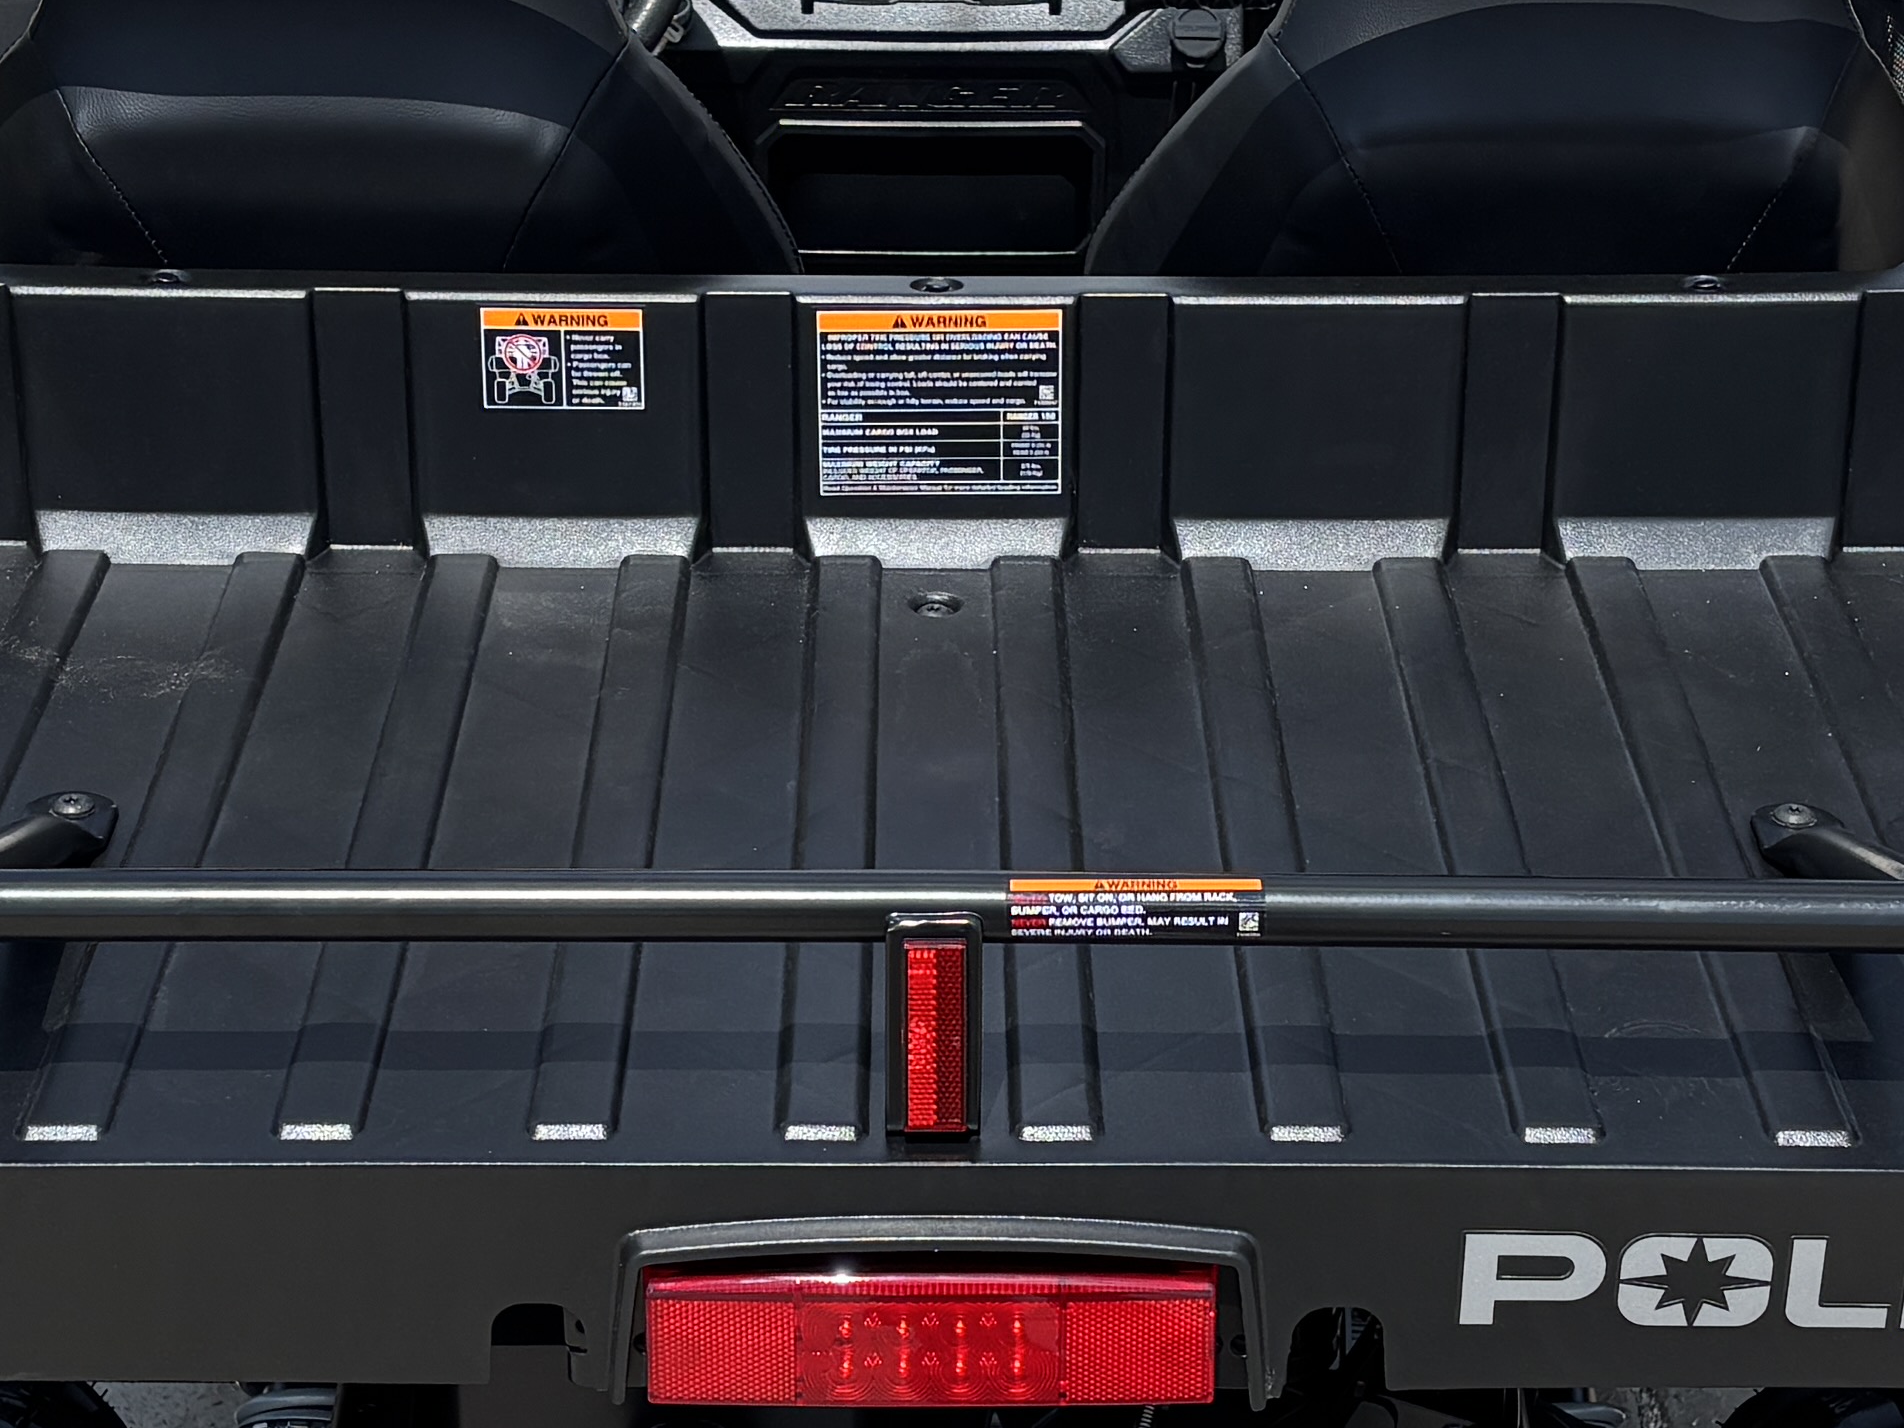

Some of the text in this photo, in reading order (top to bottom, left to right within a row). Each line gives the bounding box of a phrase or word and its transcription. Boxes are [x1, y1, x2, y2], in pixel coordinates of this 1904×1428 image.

[532, 315, 608, 326] WARNING
[910, 315, 986, 328] WARNING
[1106, 880, 1178, 890] WARNING
[1078, 893, 1095, 902] SIT
[1118, 893, 1135, 902] OR
[1137, 893, 1168, 901] HANG
[1170, 893, 1202, 901] FROM
[1062, 906, 1077, 914] OR
[1080, 906, 1119, 914] CARGO
[1049, 918, 1094, 926] REMOVE
[1147, 917, 1171, 925] MAY
[1174, 917, 1215, 925] RESULT
[1217, 917, 1228, 925] IN
